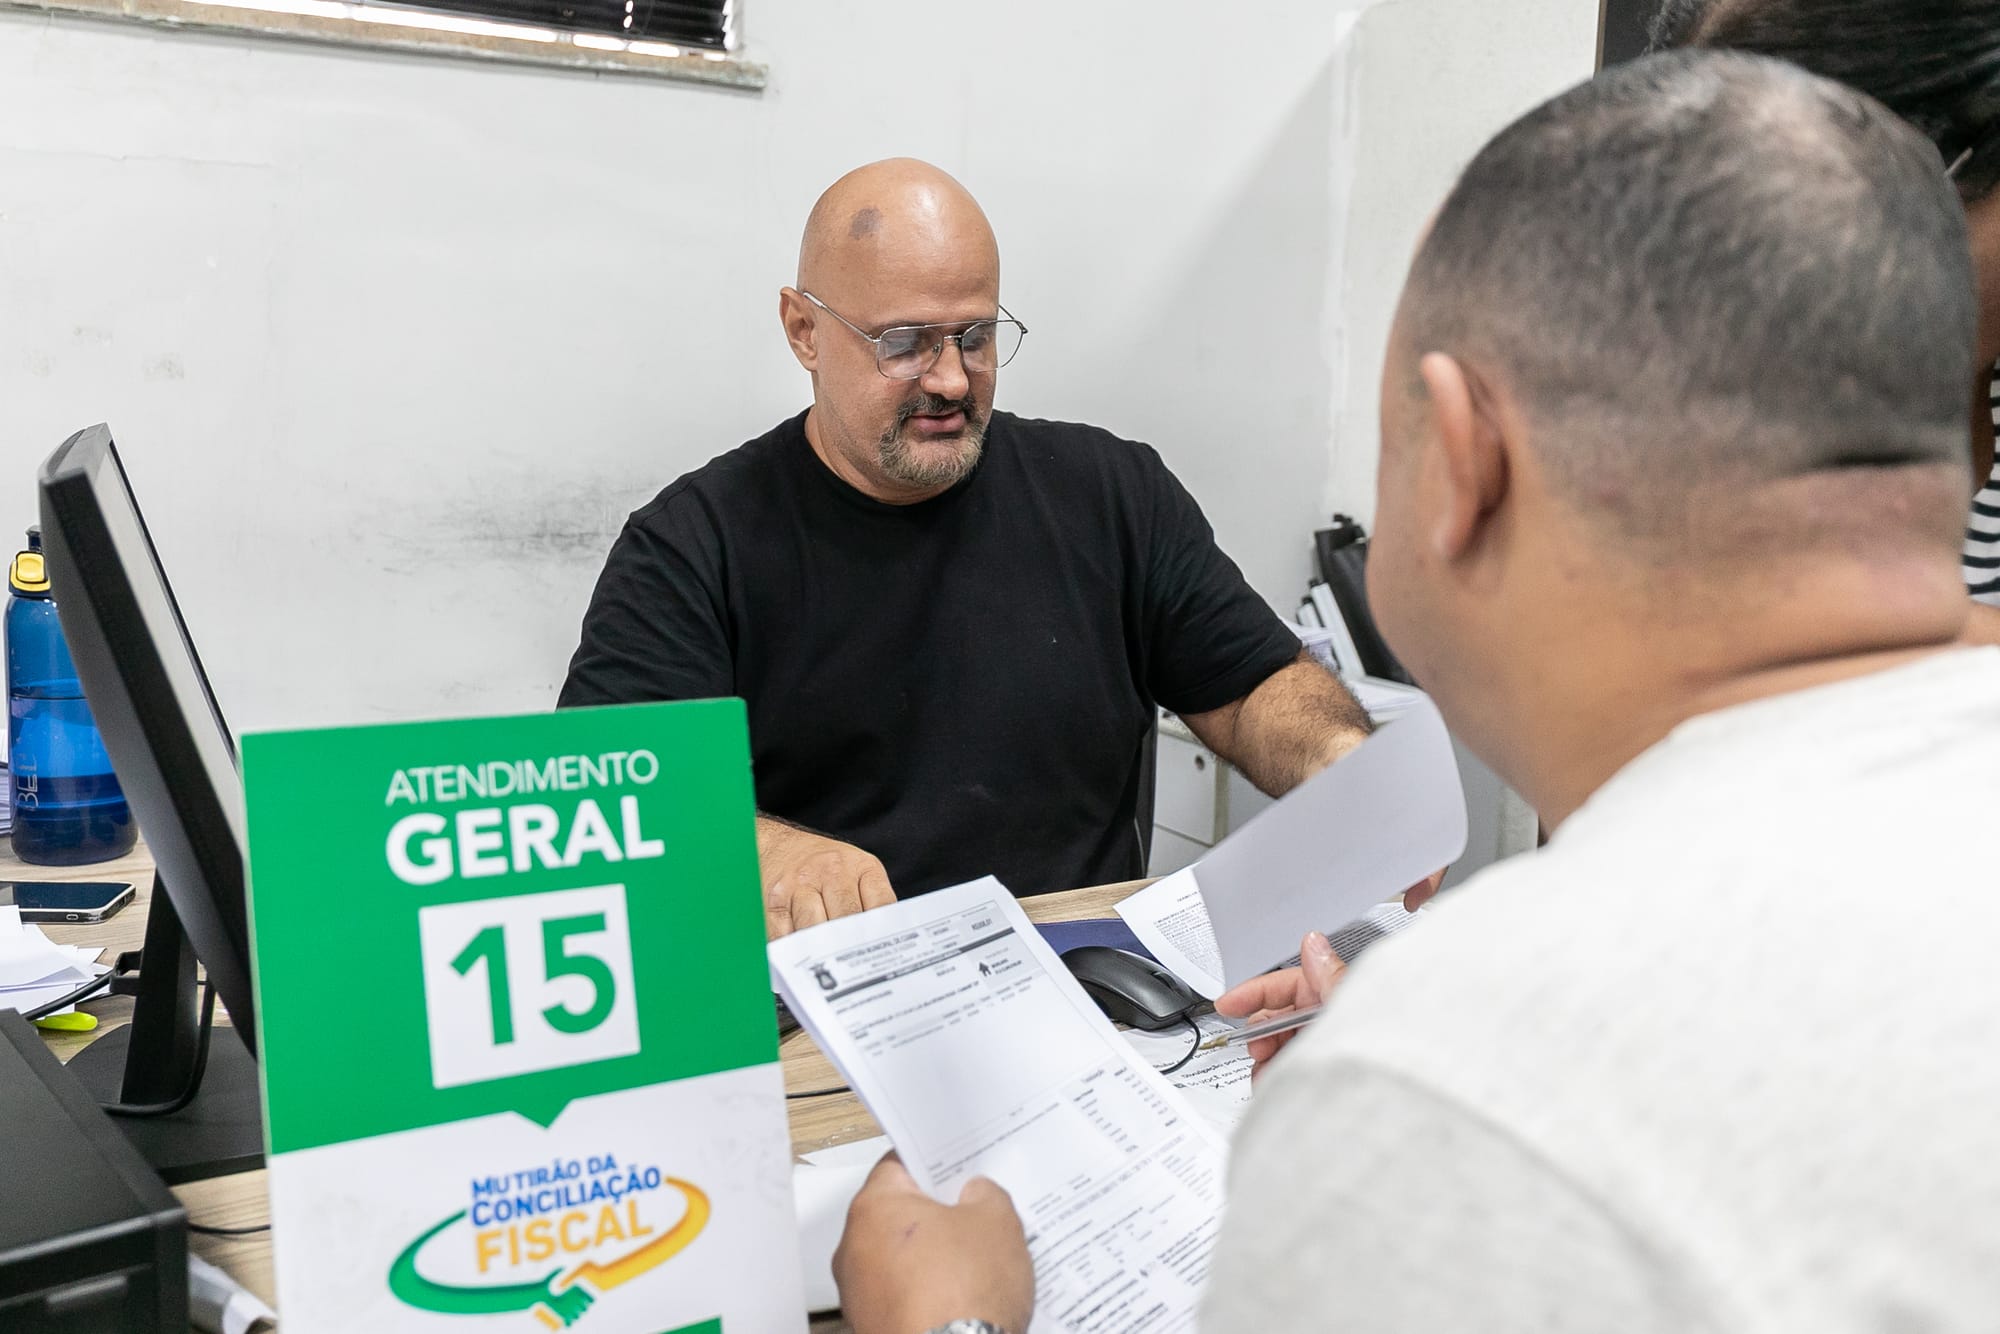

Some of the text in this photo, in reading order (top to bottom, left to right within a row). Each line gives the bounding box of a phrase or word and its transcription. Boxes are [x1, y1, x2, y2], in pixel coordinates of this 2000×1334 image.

[385, 749, 659, 806] ATENDIMENTO
[385, 795, 665, 885] GERAL
[450, 911, 616, 1046] 15
[470, 1164, 662, 1228] CONCILIAÇÃO
[471, 1152, 618, 1199] MUTIRÃO DA
[474, 1200, 653, 1275] FISCAL
